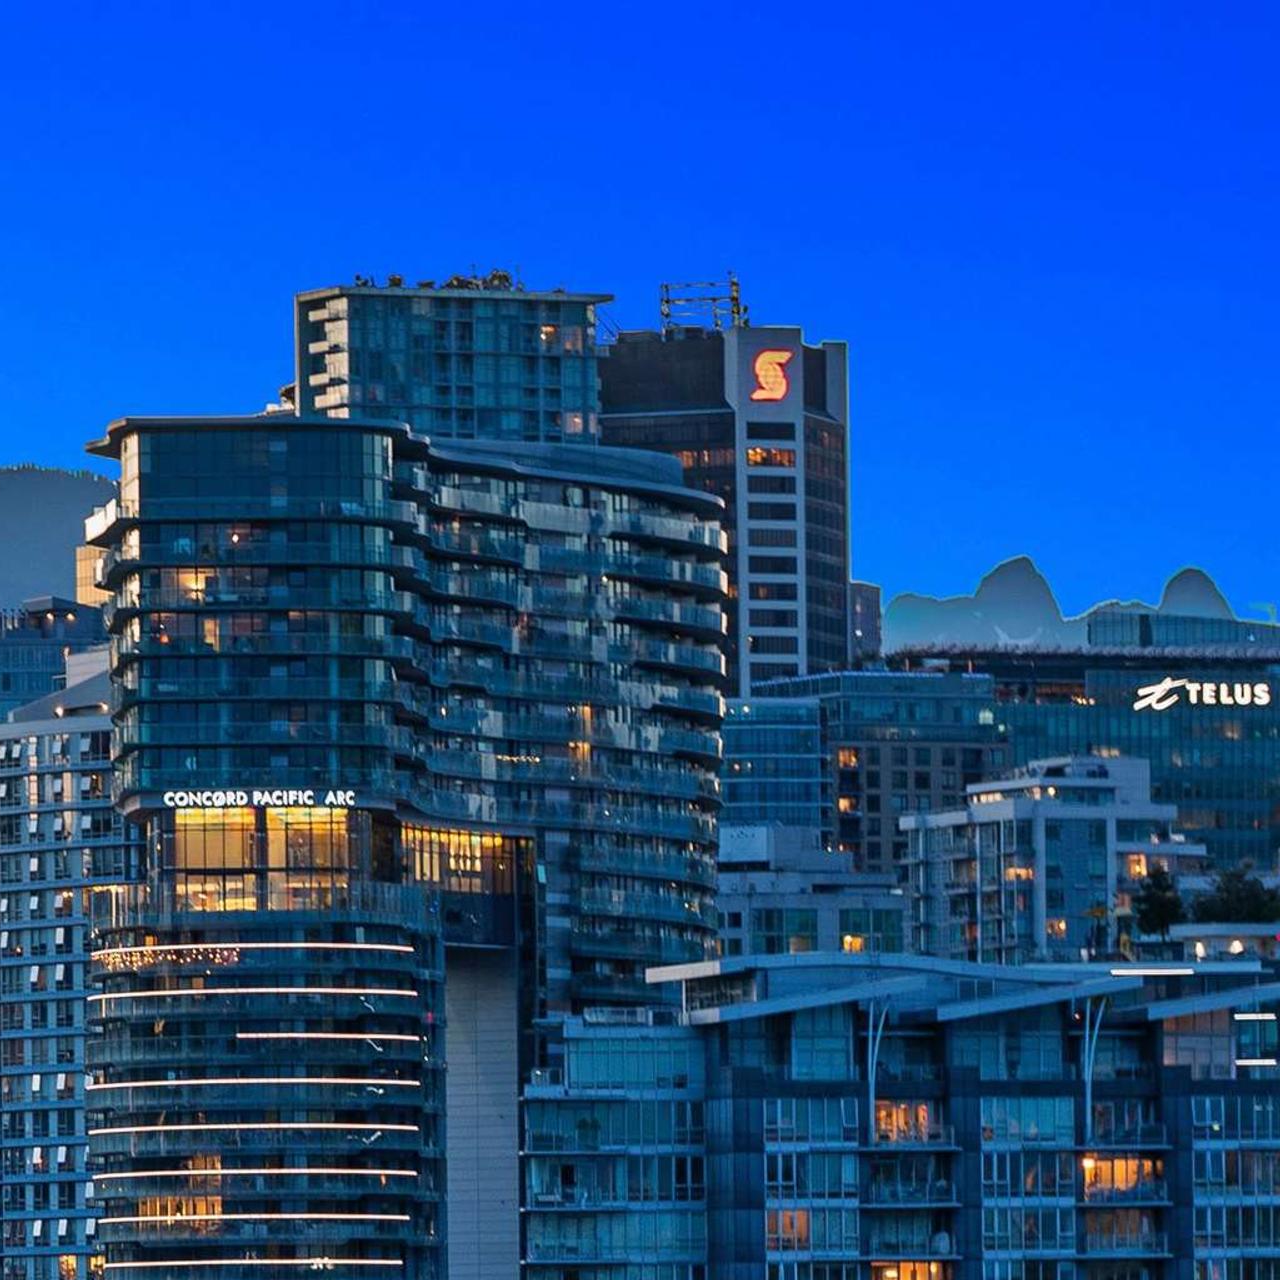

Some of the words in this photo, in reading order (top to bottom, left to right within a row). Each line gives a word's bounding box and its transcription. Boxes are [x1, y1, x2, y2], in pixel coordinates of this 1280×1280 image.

[1185, 682, 1271, 706] TELUS
[163, 791, 248, 807] CONCORD
[252, 790, 315, 806] PACIFIC
[324, 790, 356, 805] ARC
